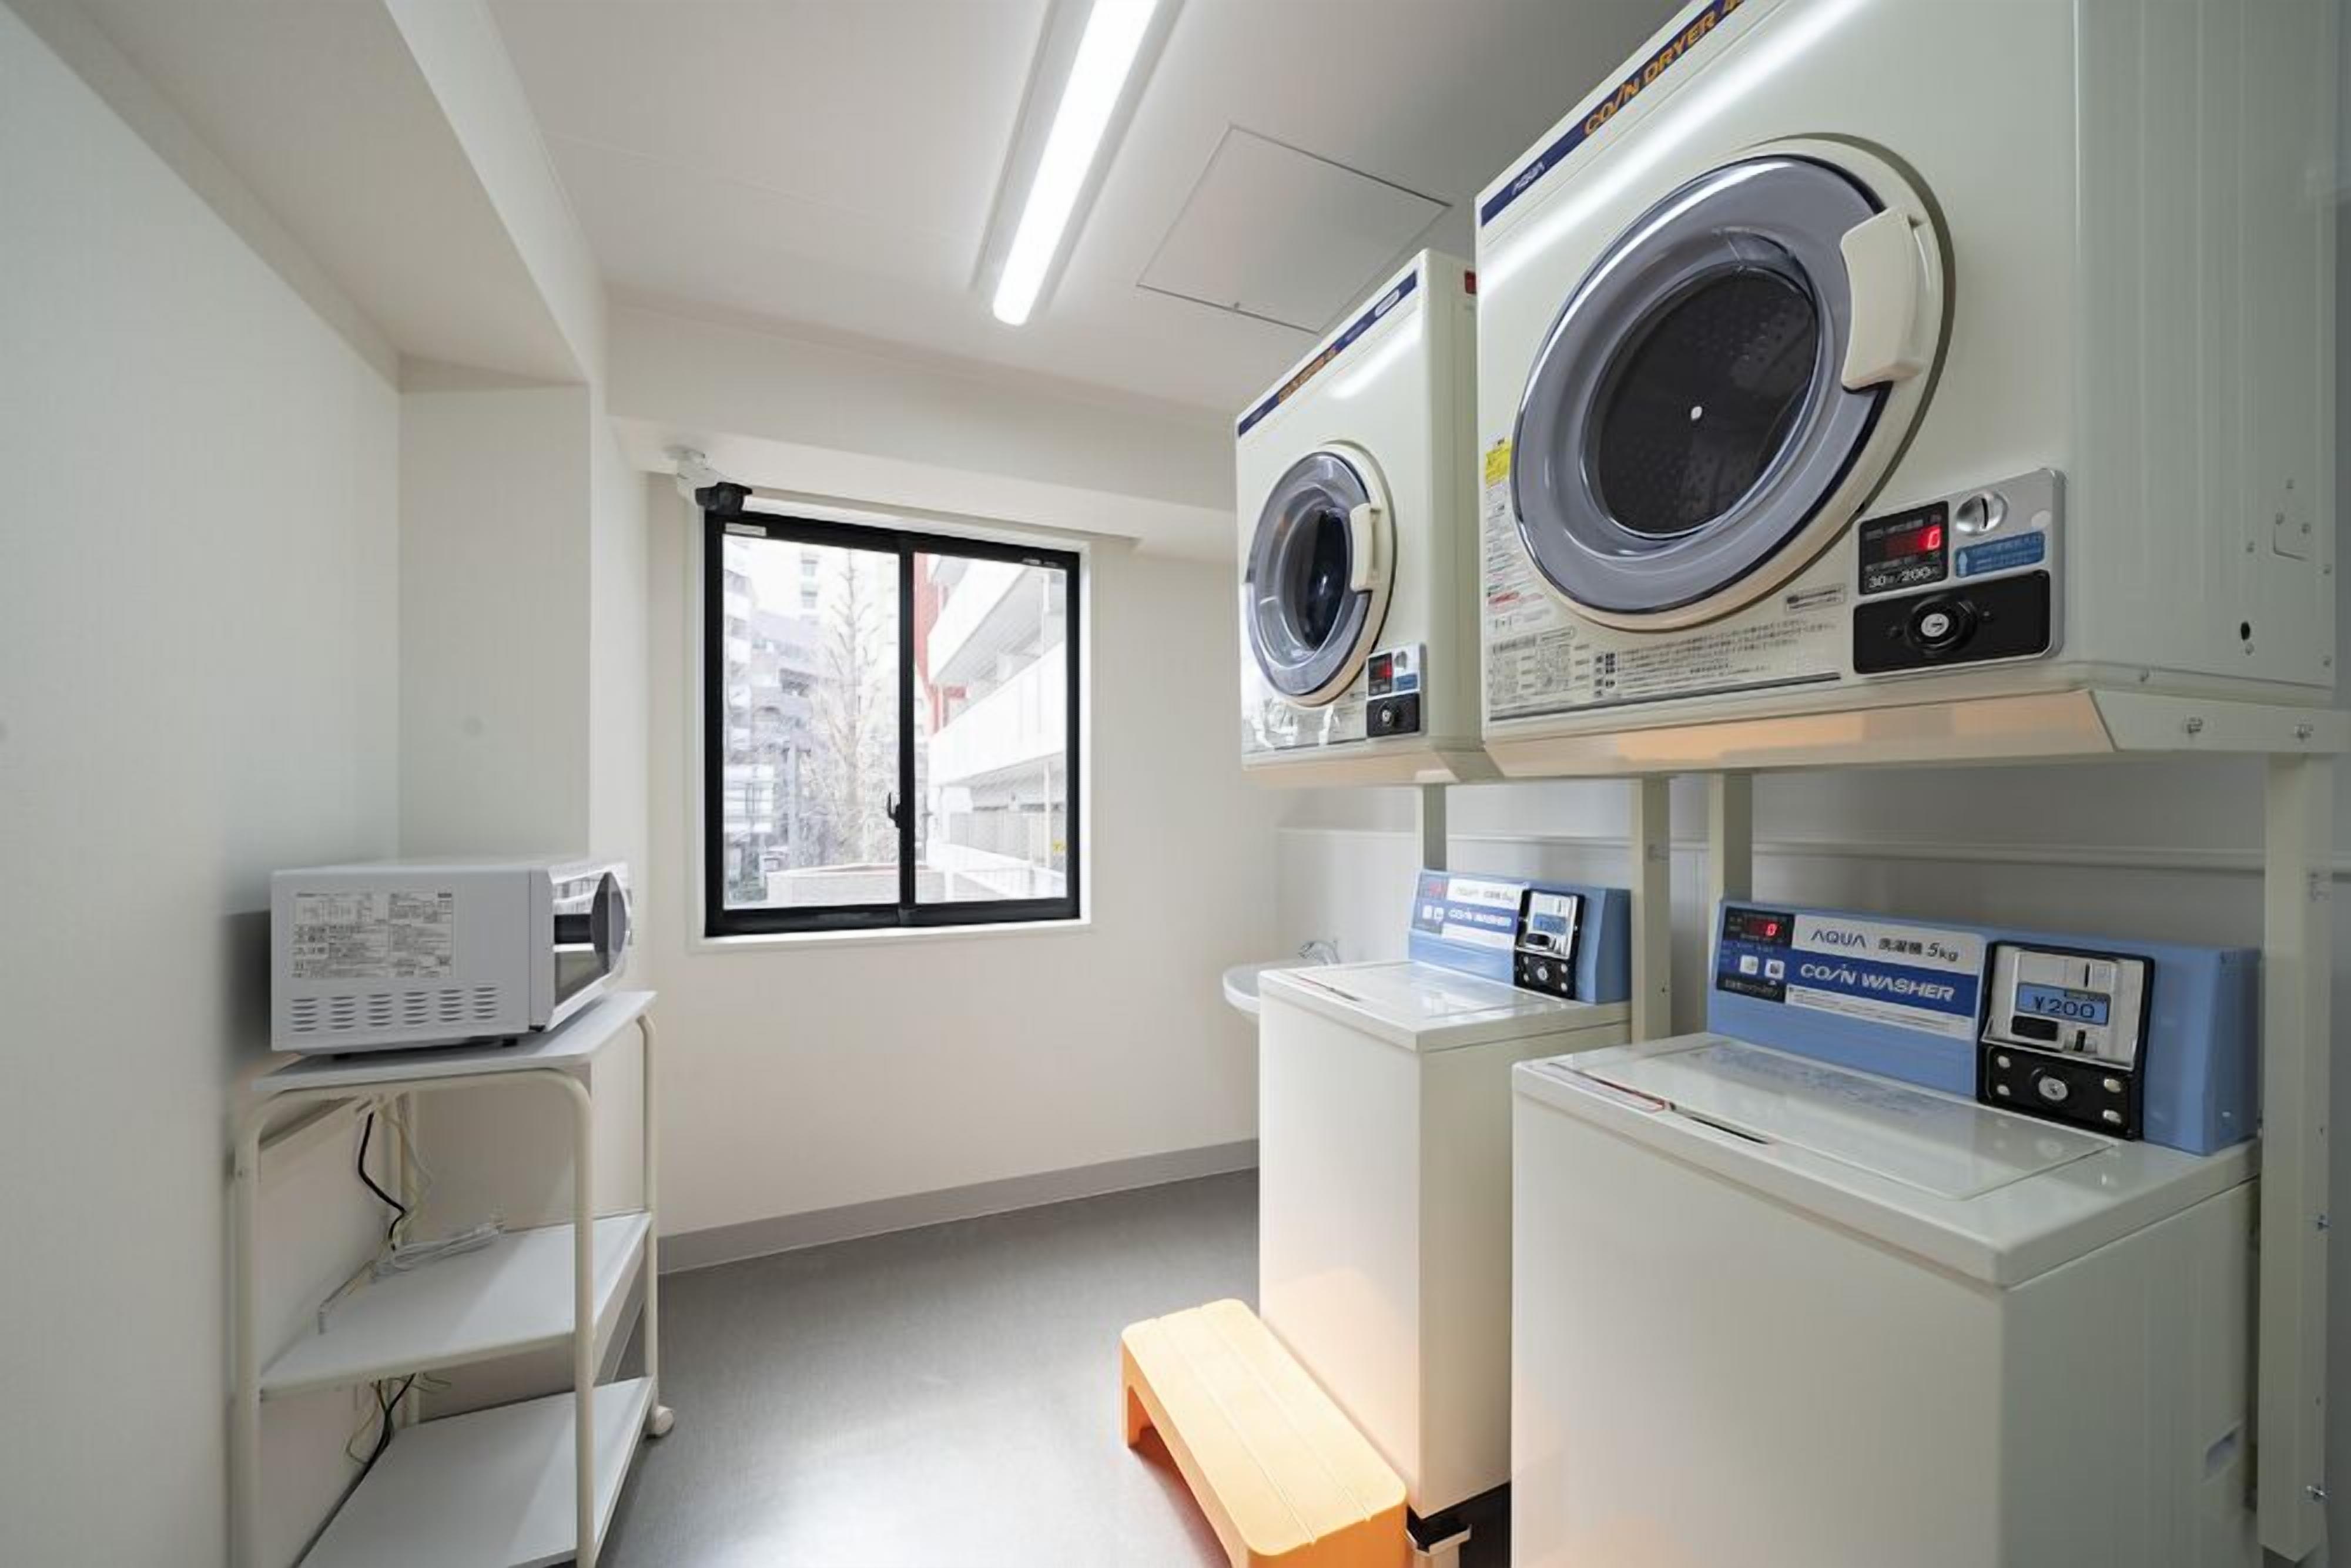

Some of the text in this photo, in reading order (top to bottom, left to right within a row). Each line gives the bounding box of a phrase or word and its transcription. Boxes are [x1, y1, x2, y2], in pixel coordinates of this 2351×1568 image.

[1643, 10, 1716, 83] DRYER
[1927, 525, 1941, 551] 0
[1810, 929, 1867, 950] AQUA
[1927, 942, 1959, 963] 5kg
[1861, 973, 1955, 1002] WASHER
[2033, 996, 2095, 1019] ¥200
